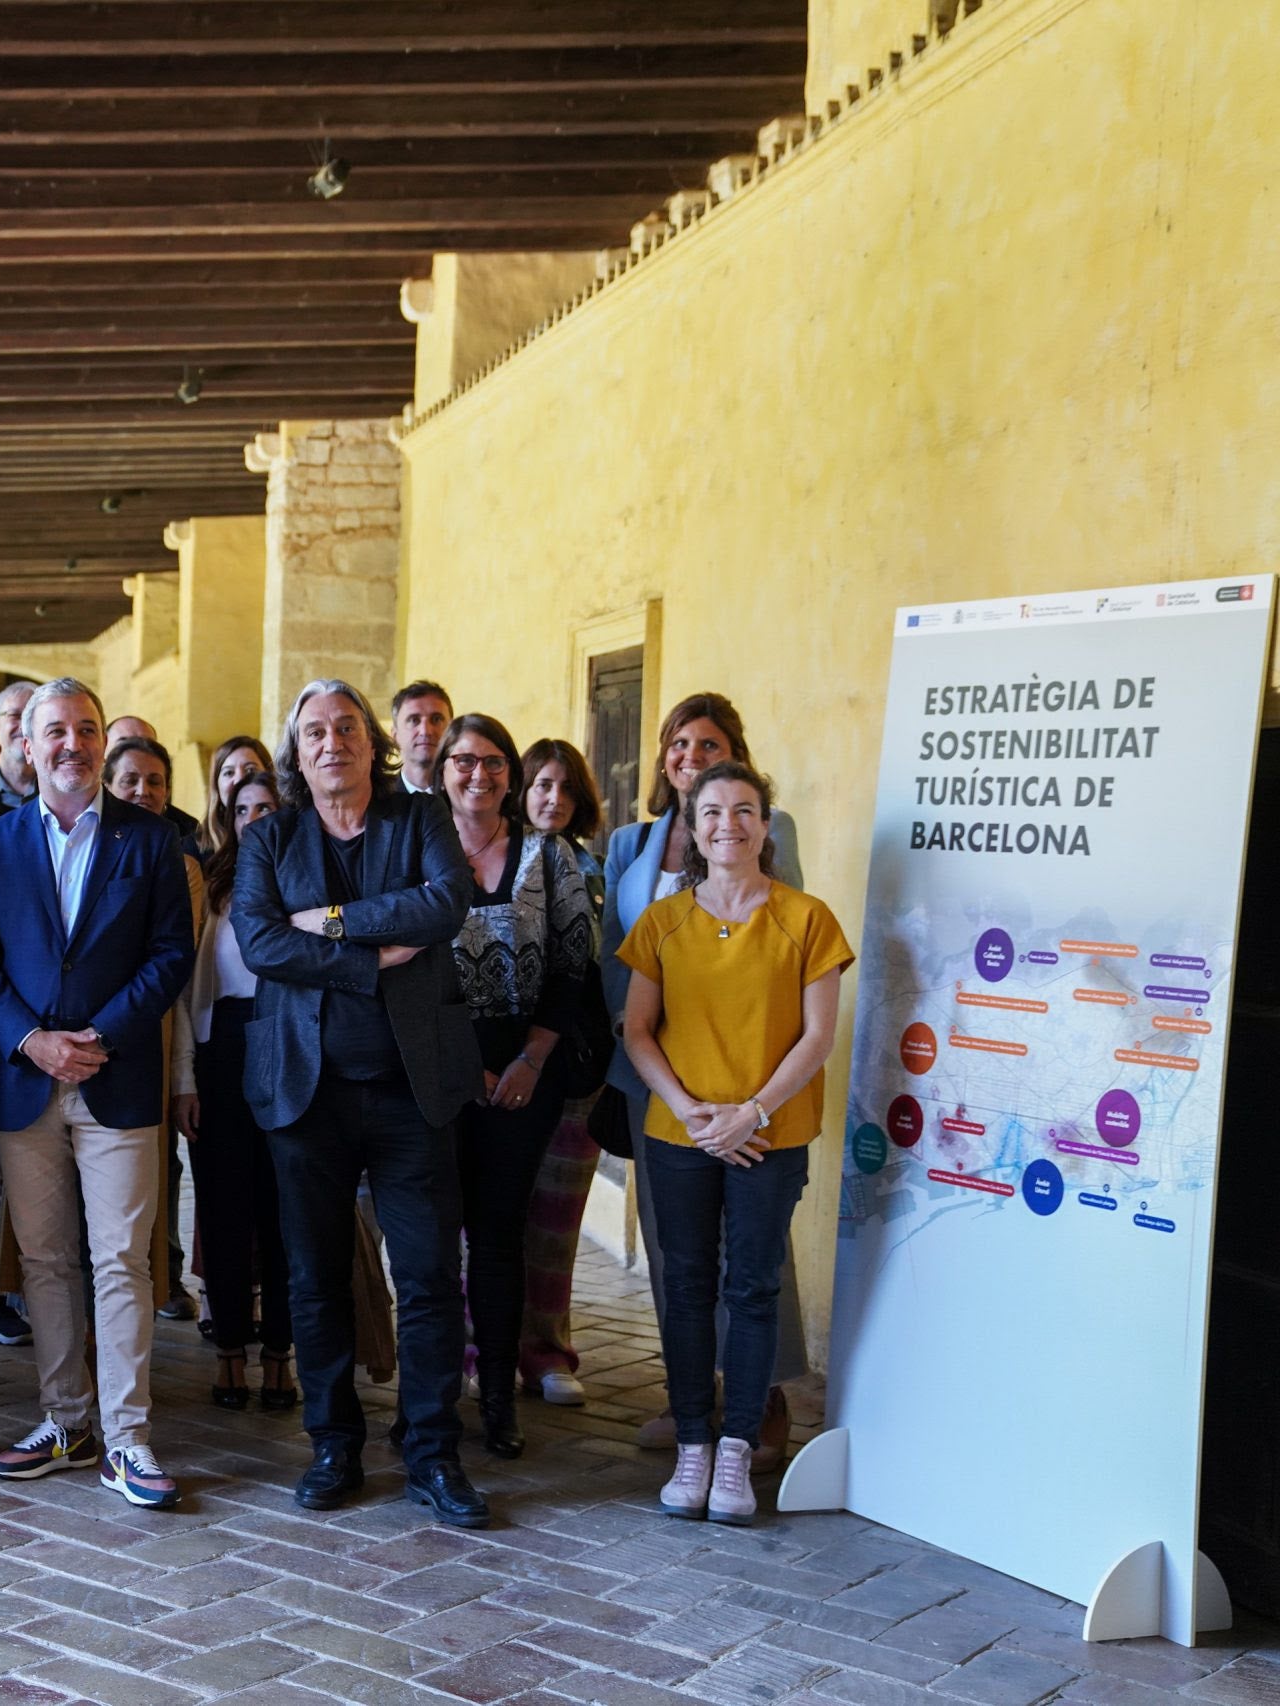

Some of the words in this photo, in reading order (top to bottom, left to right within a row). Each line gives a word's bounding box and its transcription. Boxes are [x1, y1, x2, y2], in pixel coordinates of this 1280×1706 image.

[924, 673, 1100, 716] ESTRATÈGIA
[1113, 676, 1156, 709] DE
[919, 726, 1160, 761] SOSTENIBILITAT
[915, 767, 1061, 807] TURÍSTICA
[1074, 776, 1115, 807] DE
[910, 821, 1091, 856] BARCELONA
